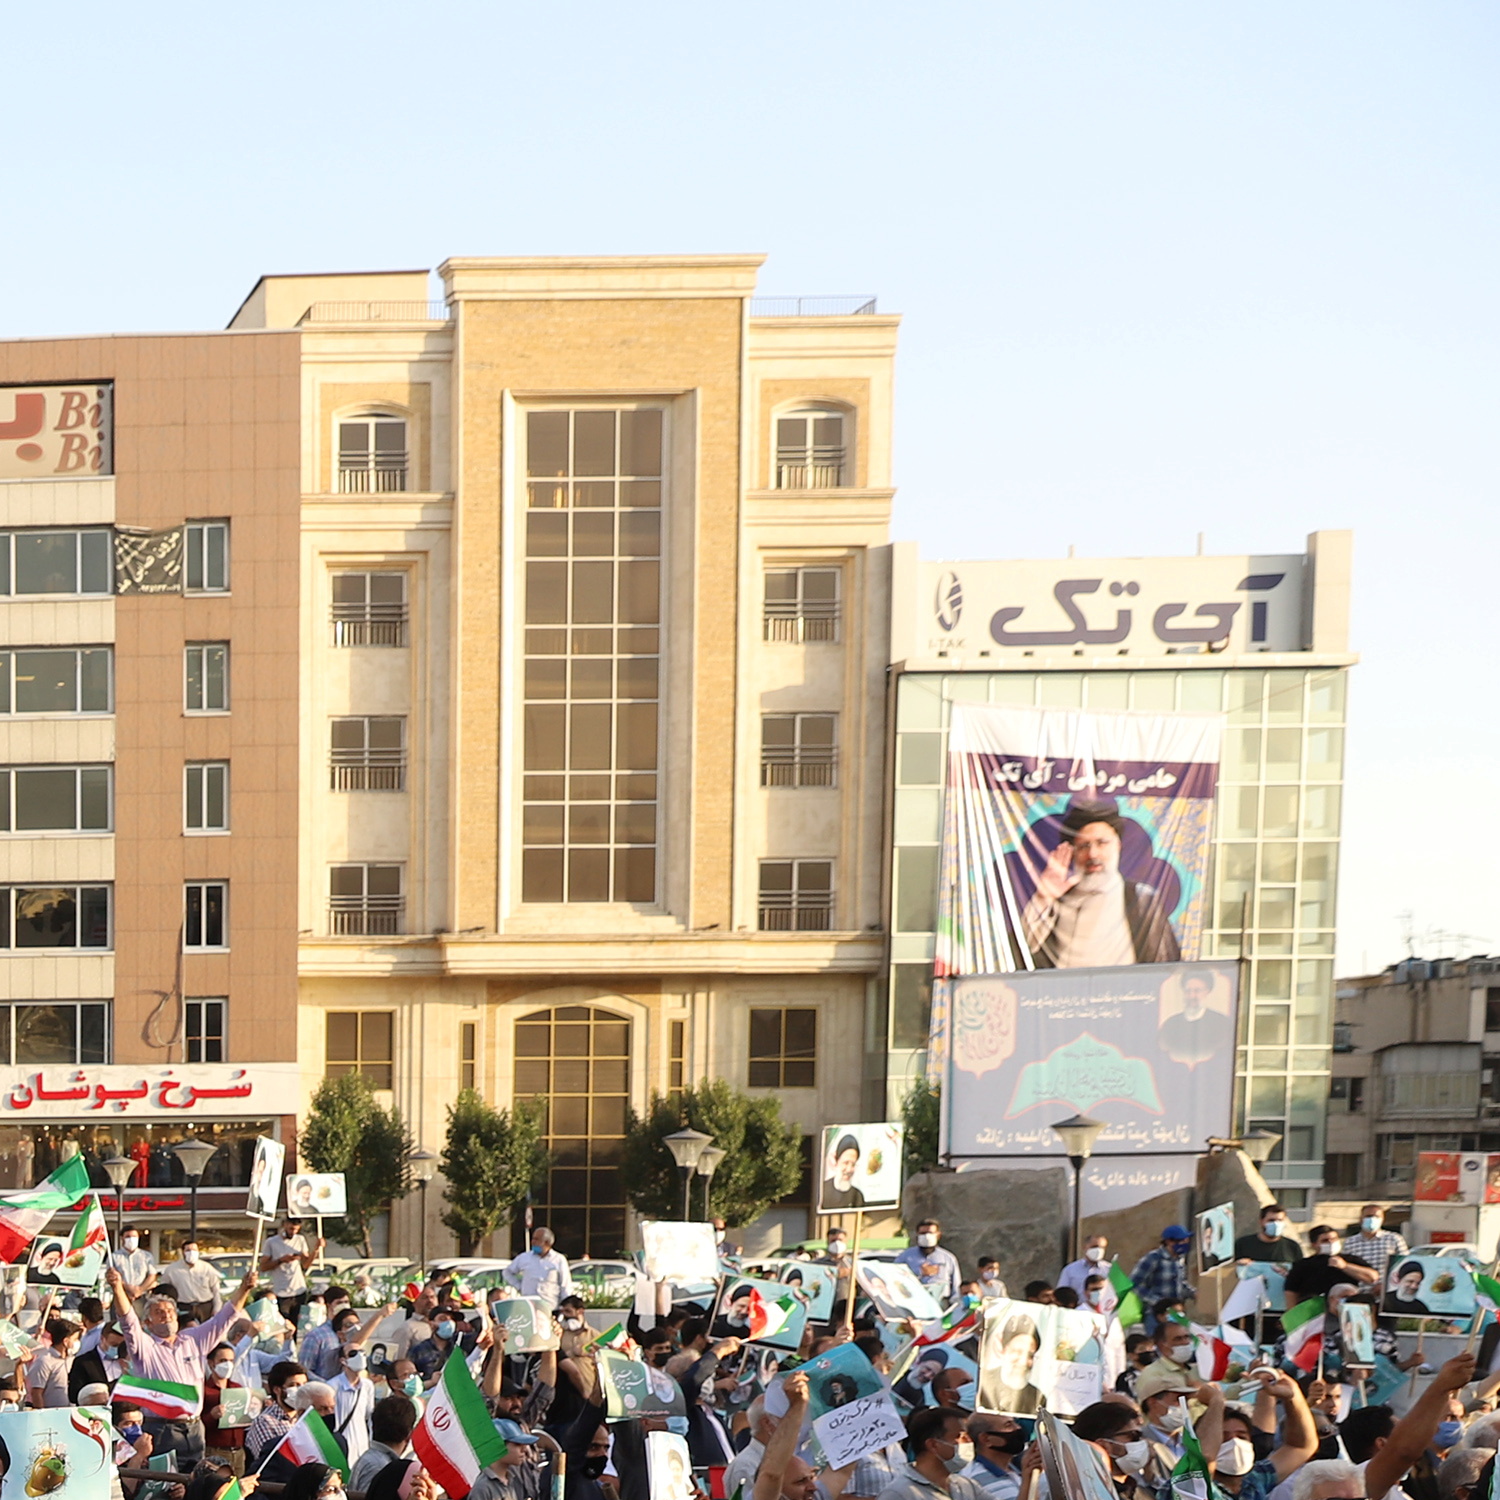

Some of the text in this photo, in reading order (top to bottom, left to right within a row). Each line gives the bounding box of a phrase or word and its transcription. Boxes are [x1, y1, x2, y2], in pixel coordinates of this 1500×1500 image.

[55, 386, 105, 431] Bi
[55, 431, 105, 474] Bi
[990, 573, 1285, 646] آی تک
[10, 1071, 148, 1110] پوشان
